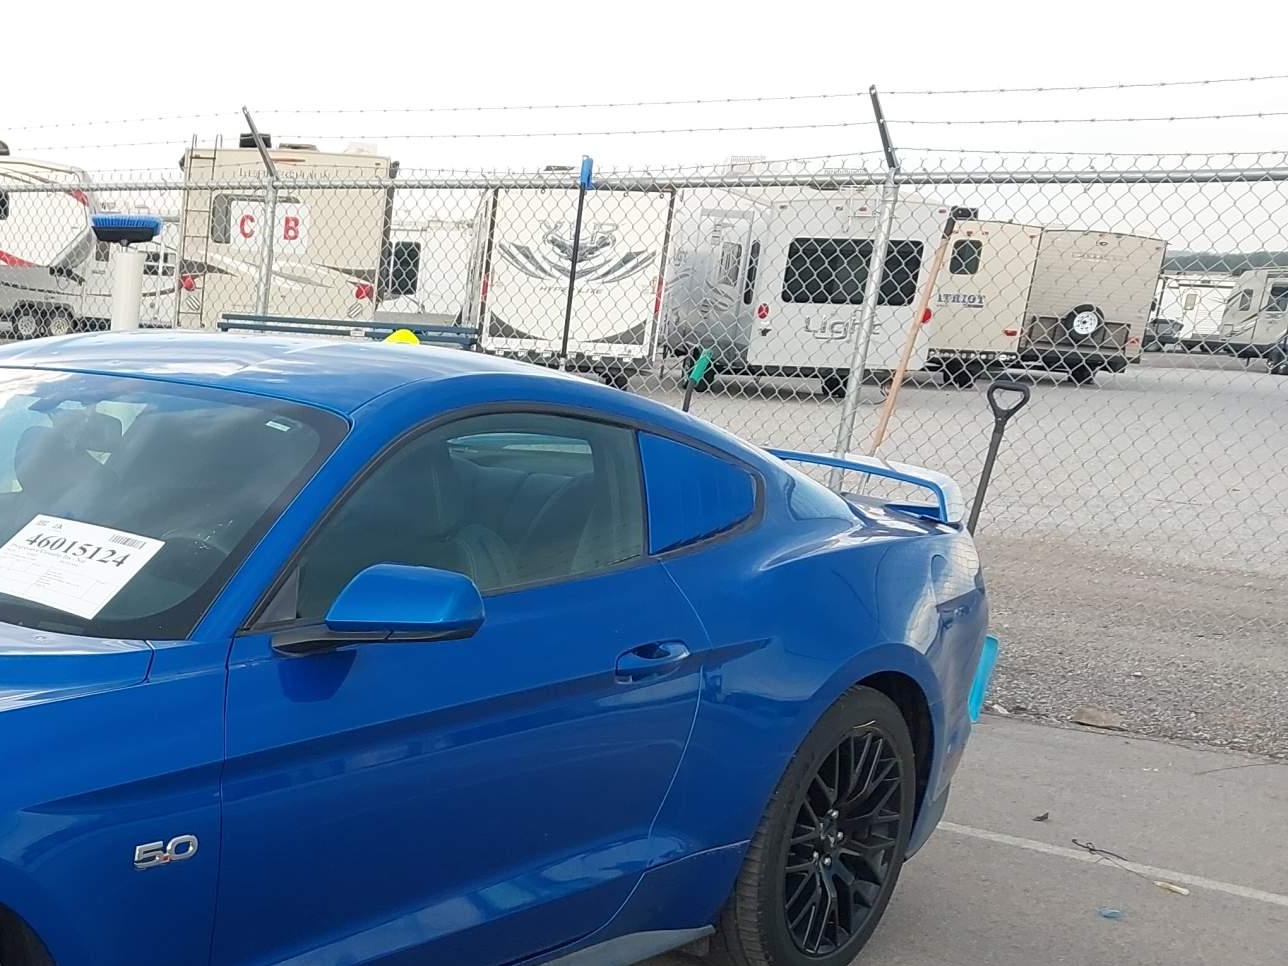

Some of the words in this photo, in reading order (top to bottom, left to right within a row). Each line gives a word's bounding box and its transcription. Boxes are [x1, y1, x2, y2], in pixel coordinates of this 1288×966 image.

[239, 214, 256, 239] C
[283, 216, 300, 240] B
[25, 533, 131, 567] 46015124
[133, 834, 199, 871] 5.0
